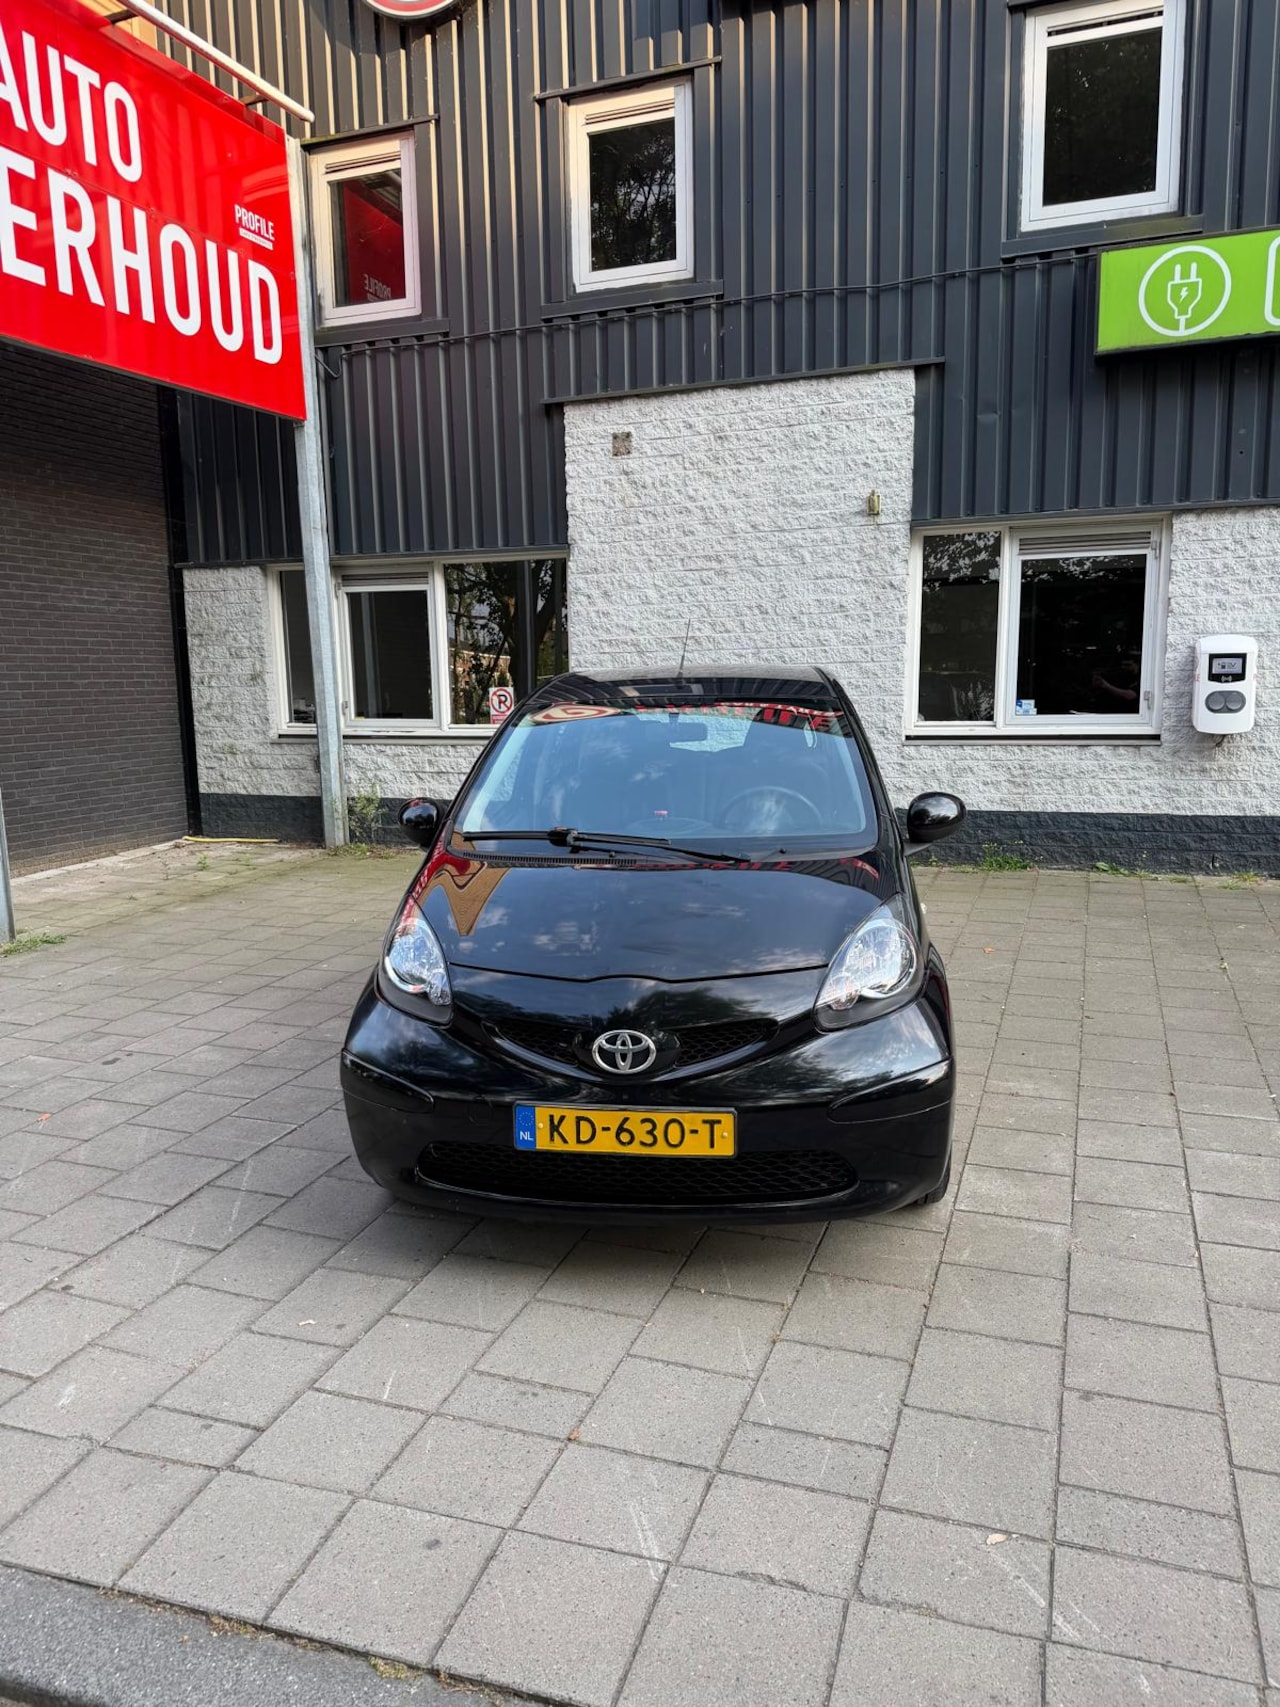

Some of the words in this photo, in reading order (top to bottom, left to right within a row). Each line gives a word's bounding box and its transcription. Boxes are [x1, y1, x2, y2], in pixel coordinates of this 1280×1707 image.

[234, 204, 275, 241] PROFILE
[0, 145, 282, 364] ERHOUD
[519, 1131, 534, 1141] NL
[548, 1114, 722, 1149] KD-630-T
